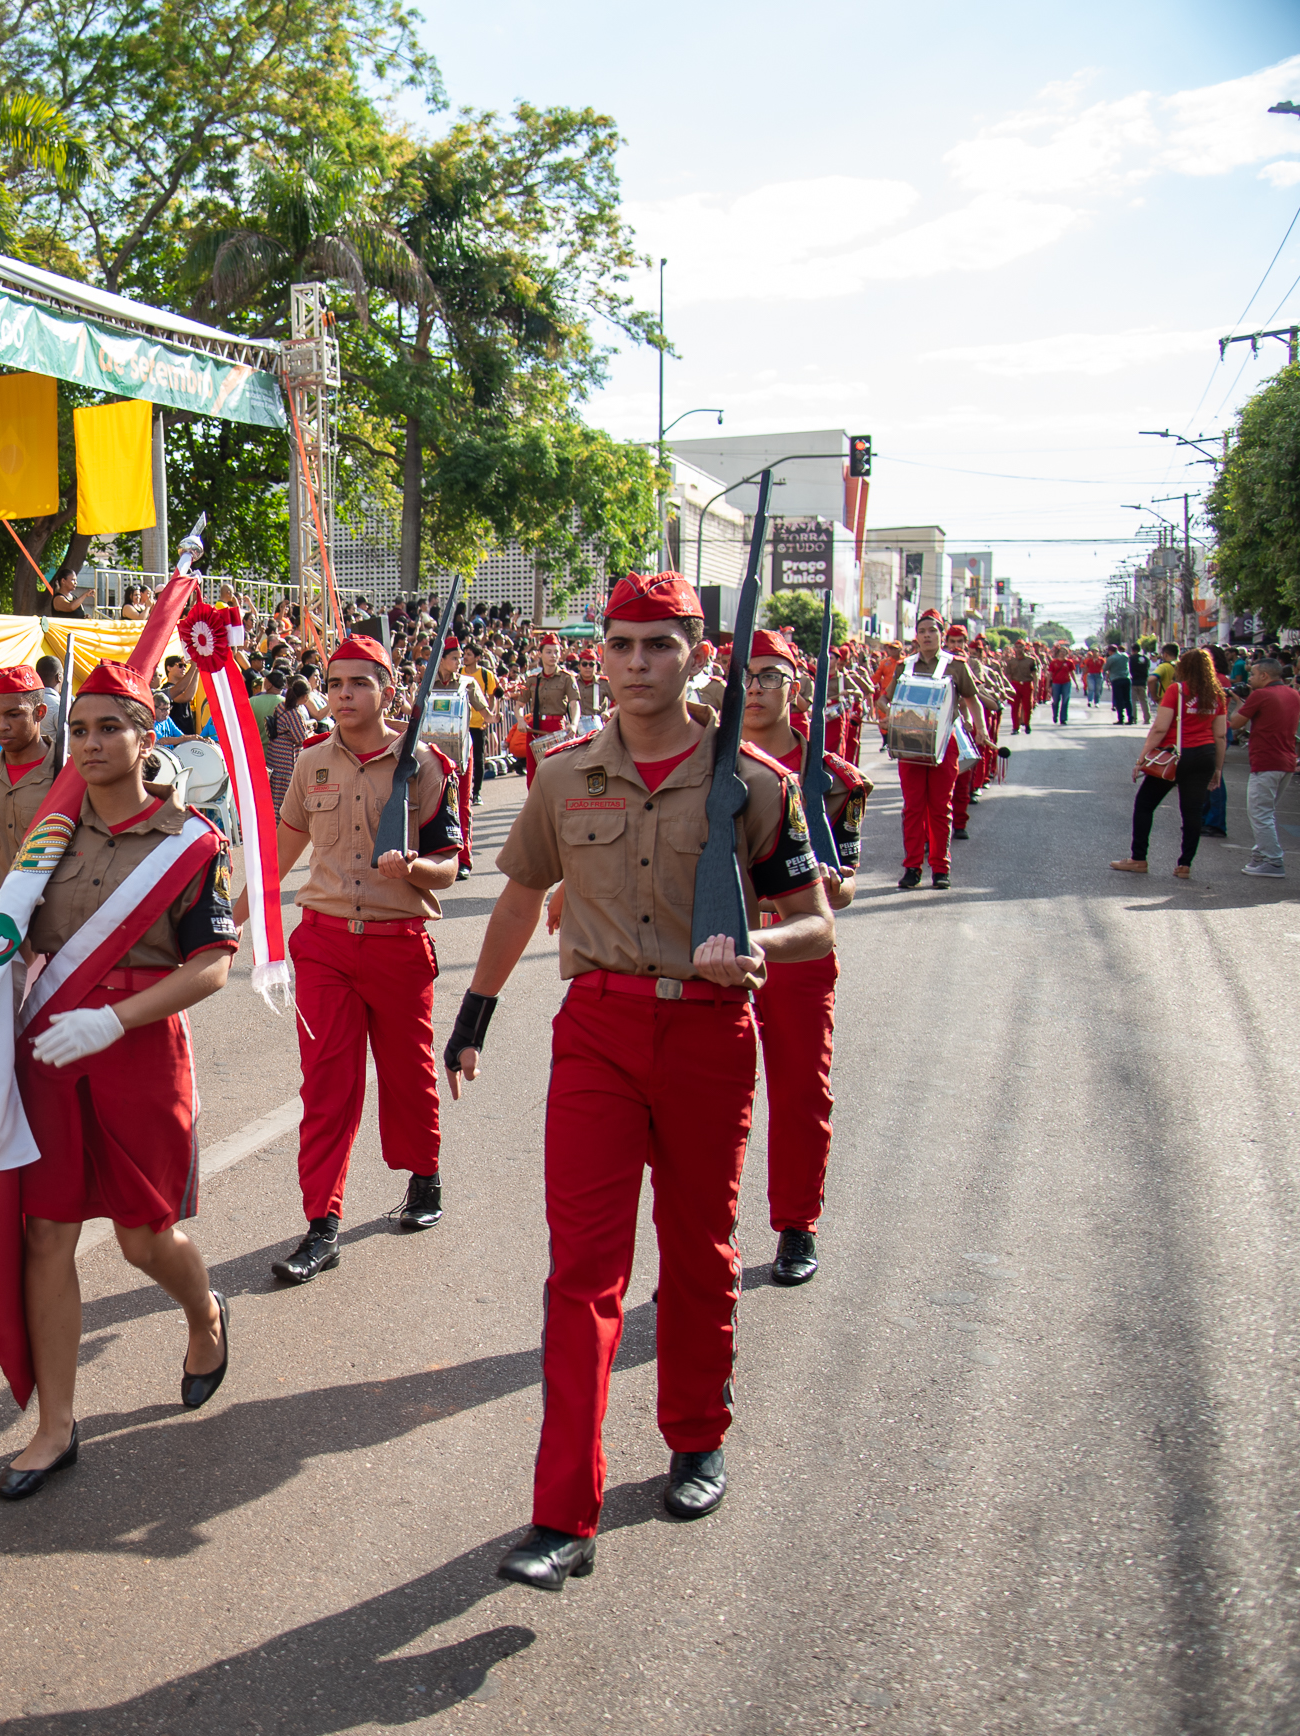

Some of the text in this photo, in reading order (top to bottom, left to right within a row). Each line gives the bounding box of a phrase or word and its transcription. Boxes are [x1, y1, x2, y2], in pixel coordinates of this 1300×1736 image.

[130, 352, 213, 399] setembro
[780, 532, 828, 541] TORRA
[782, 560, 827, 573] Preço
[782, 570, 826, 584] Único
